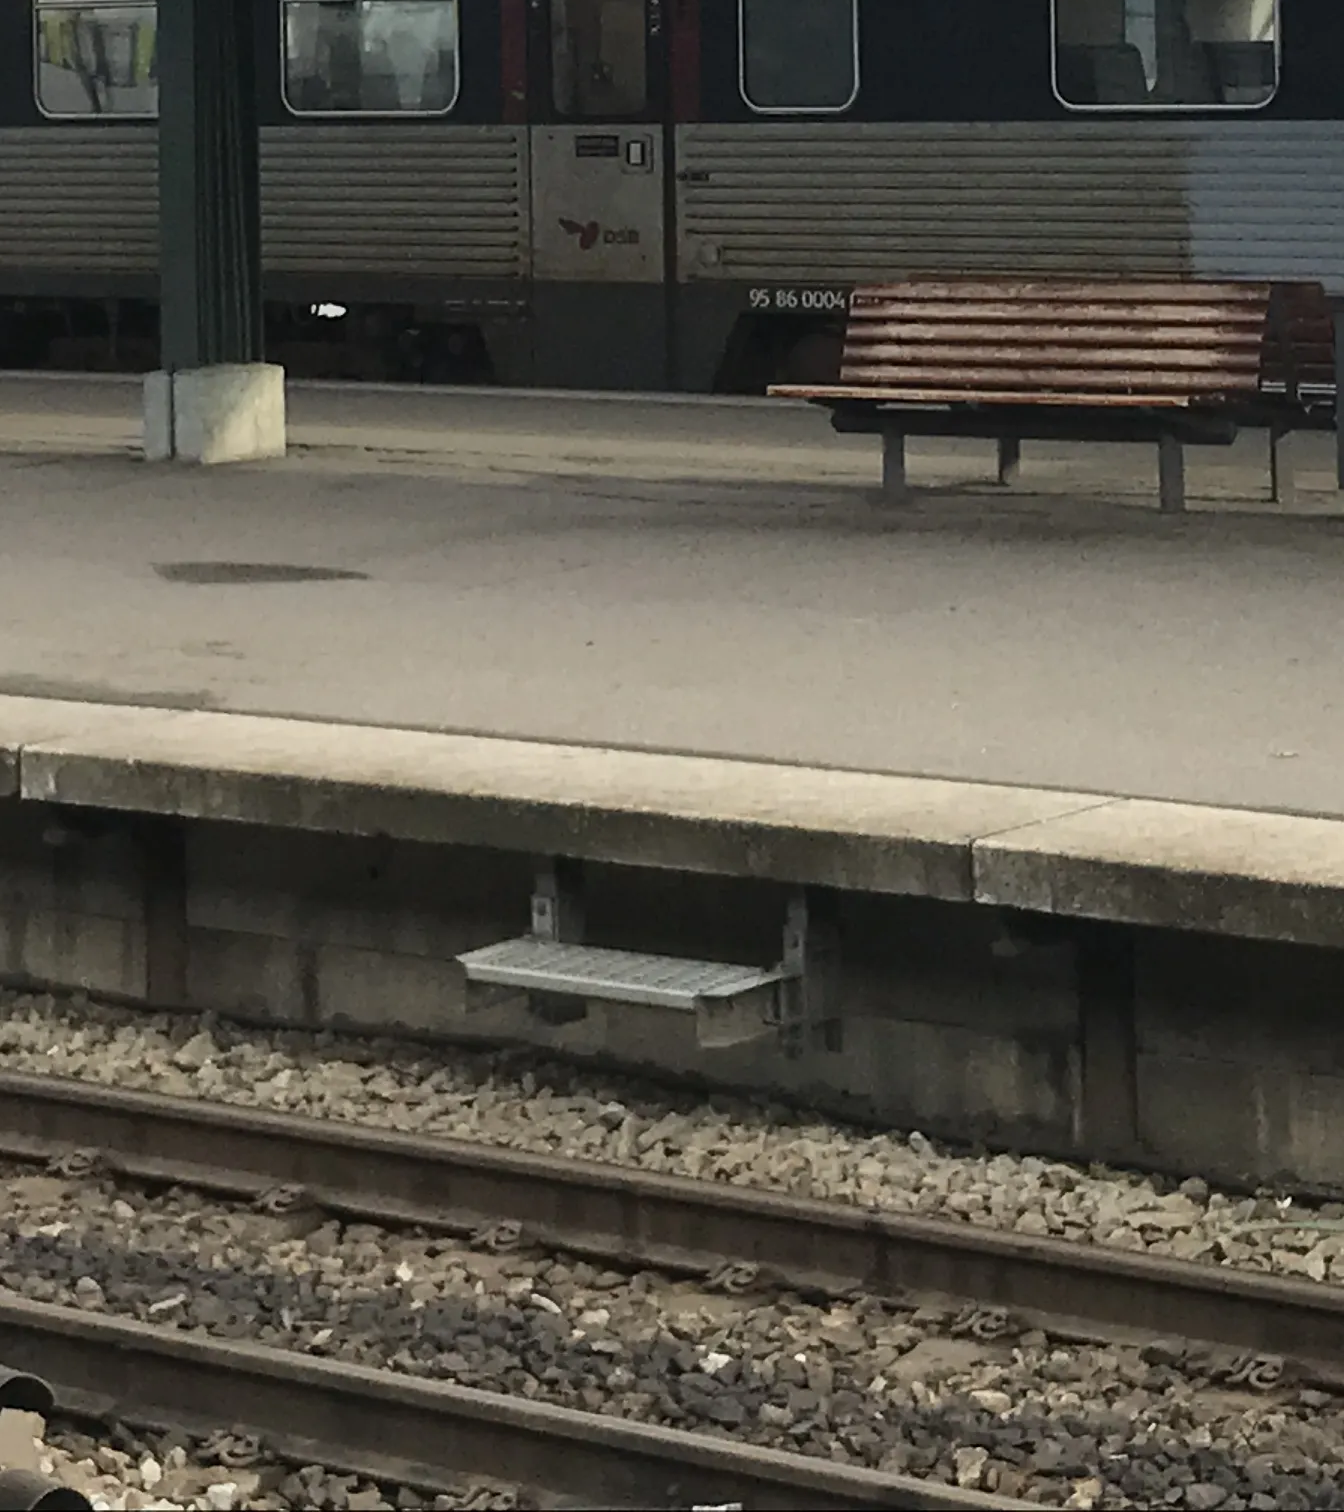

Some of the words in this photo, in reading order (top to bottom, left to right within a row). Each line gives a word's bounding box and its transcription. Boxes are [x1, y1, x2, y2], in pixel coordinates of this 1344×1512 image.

[749, 288, 770, 308] 95
[776, 290, 798, 308] 86
[802, 290, 846, 309] 0004
